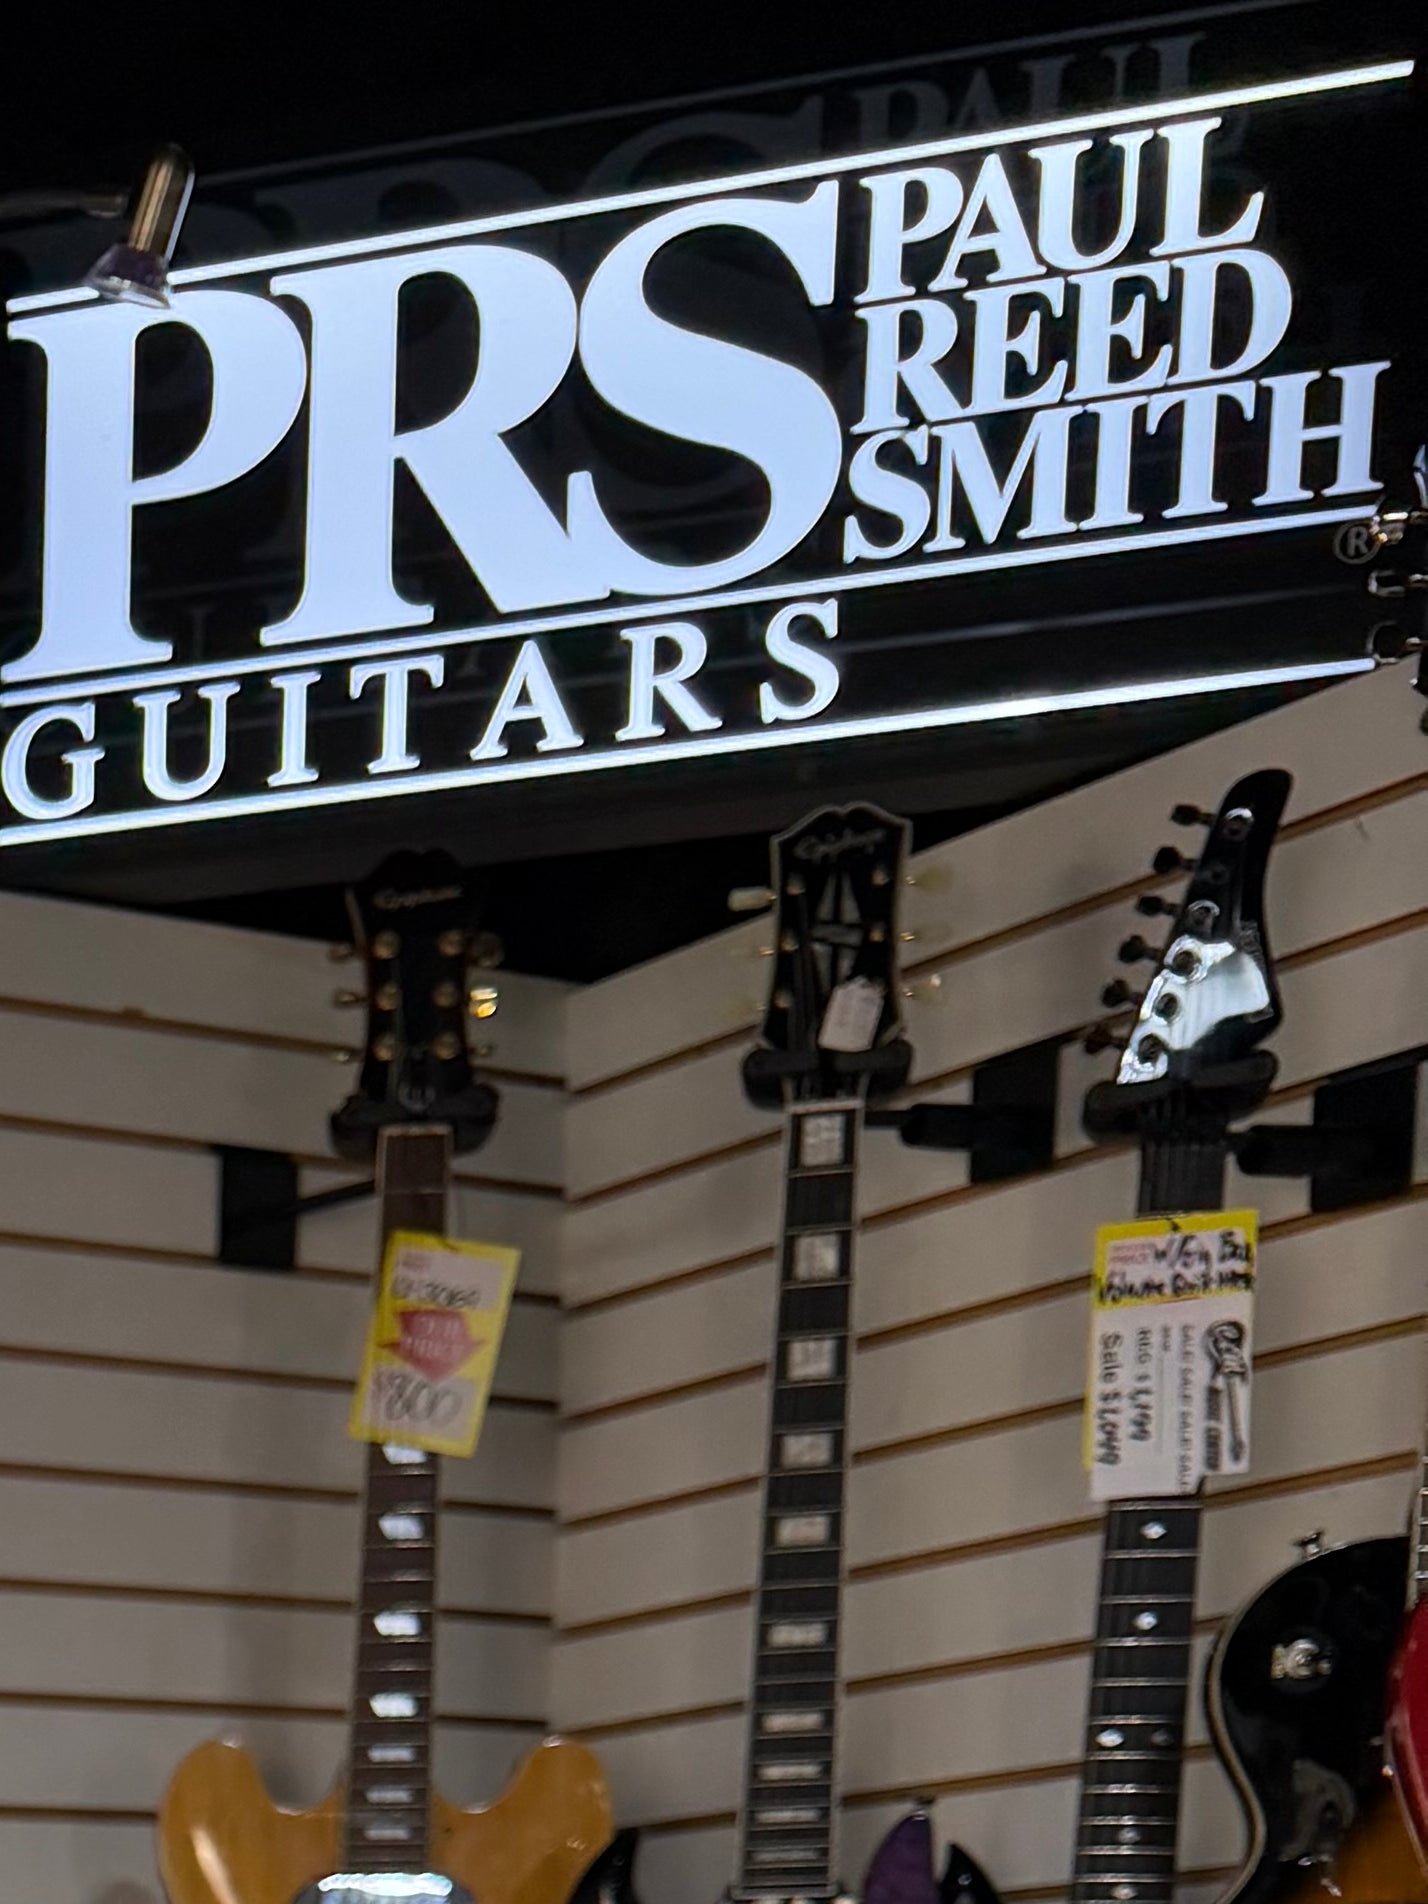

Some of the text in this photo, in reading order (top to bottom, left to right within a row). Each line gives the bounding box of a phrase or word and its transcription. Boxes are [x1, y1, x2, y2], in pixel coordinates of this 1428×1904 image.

[856, 116, 1267, 305] PAUL
[0, 181, 844, 684] PRS
[852, 247, 1293, 437] REED
[844, 360, 1394, 566] SMITH
[0, 597, 845, 821] GUITARS
[1100, 1332, 1125, 1384] Sale
